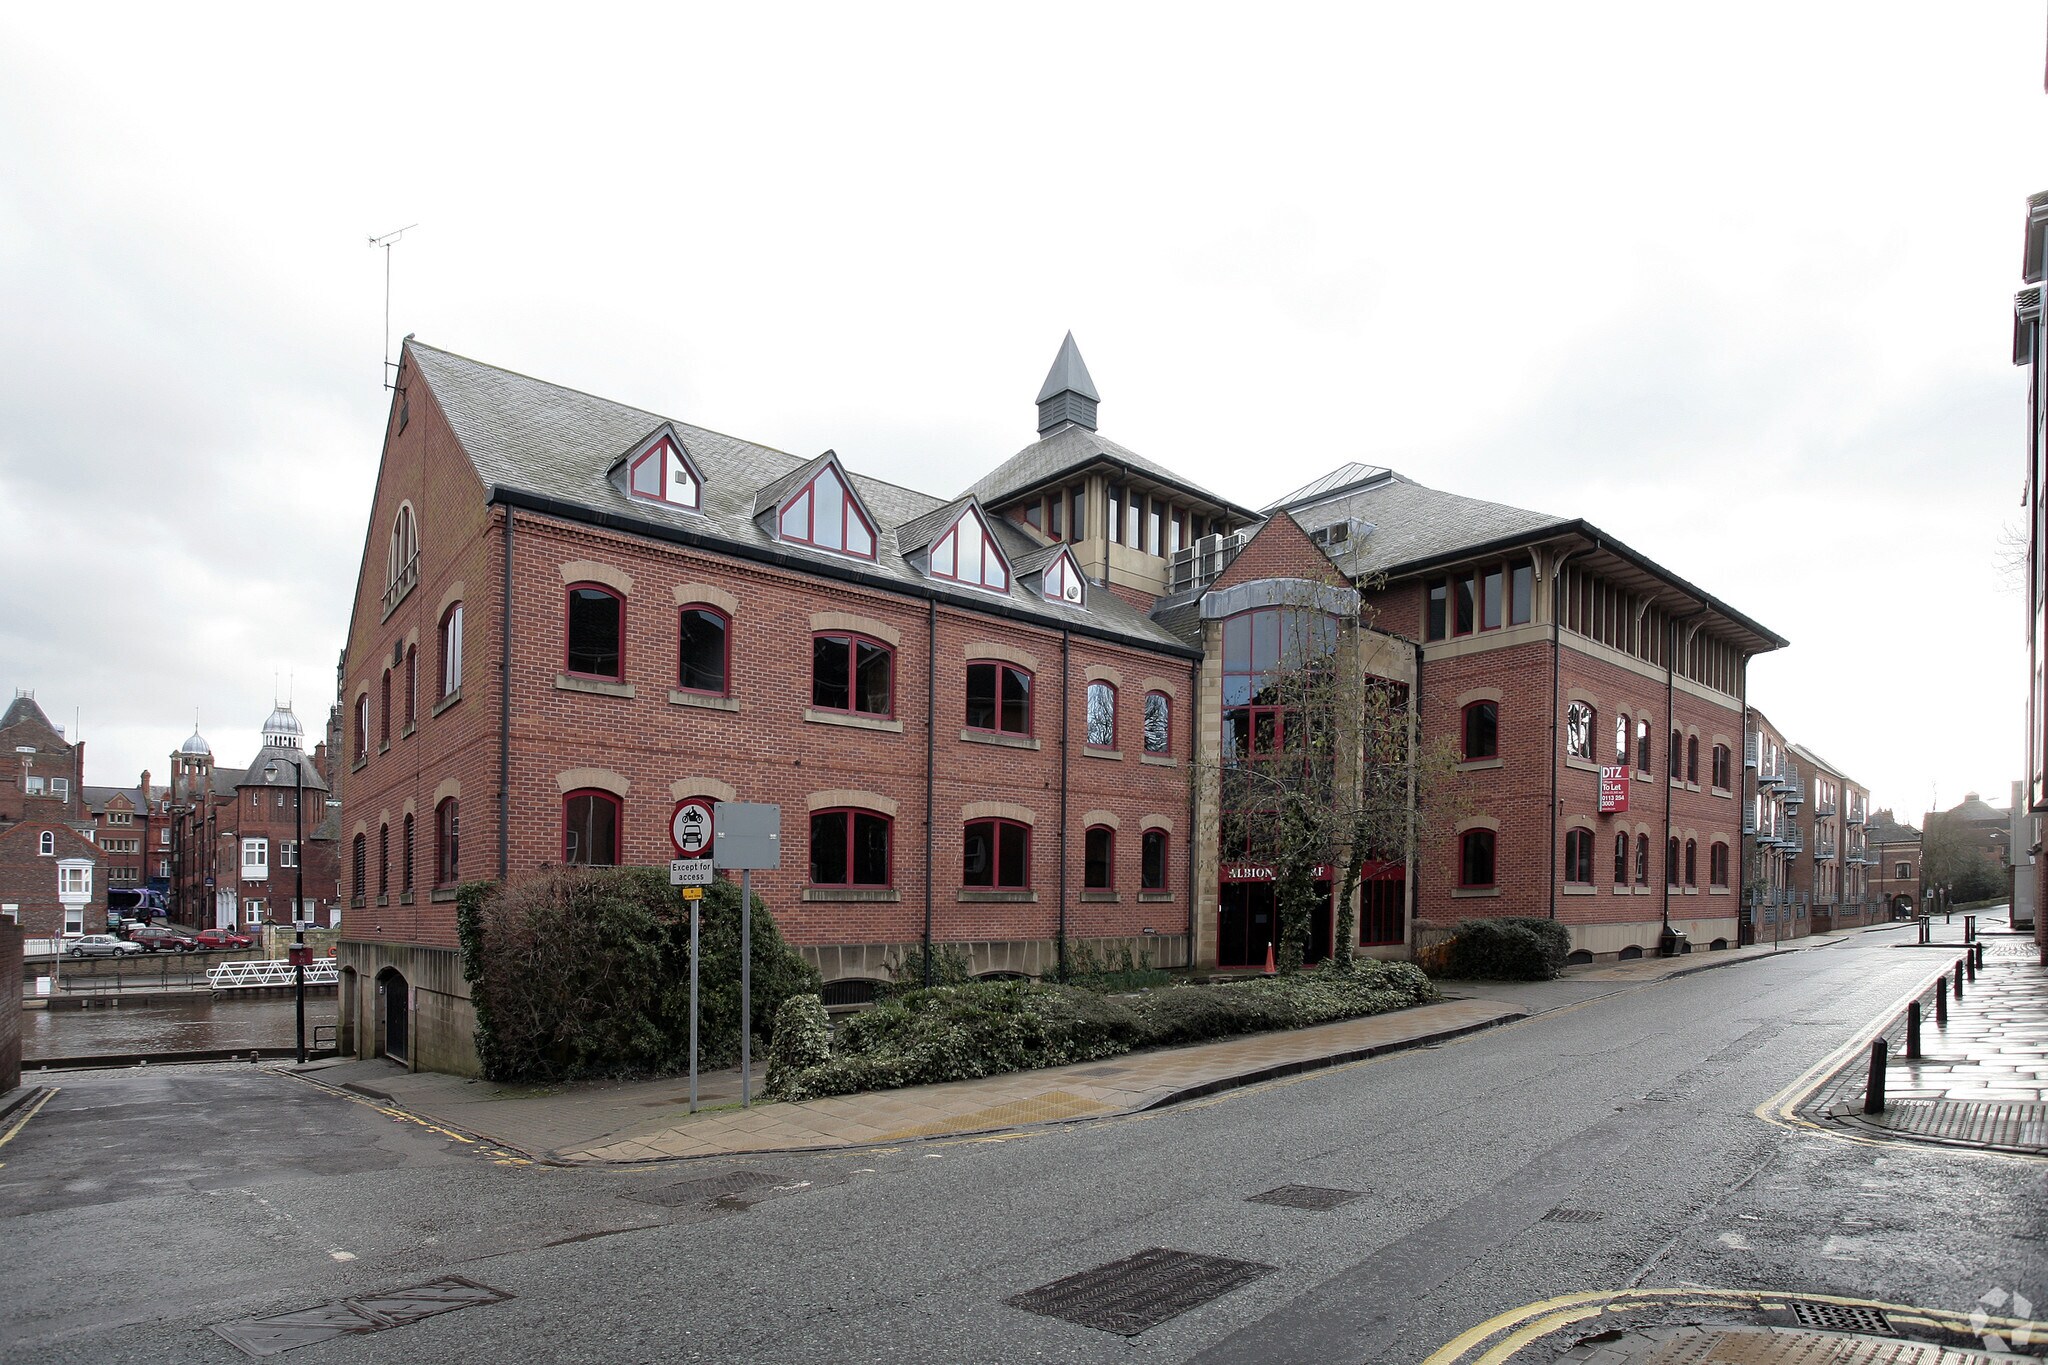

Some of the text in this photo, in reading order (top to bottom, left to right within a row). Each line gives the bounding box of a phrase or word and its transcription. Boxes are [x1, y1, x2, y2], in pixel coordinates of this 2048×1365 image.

[1603, 767, 1621, 778] DTZ
[672, 863, 697, 872] Except
[1229, 867, 1273, 878] ALBION
